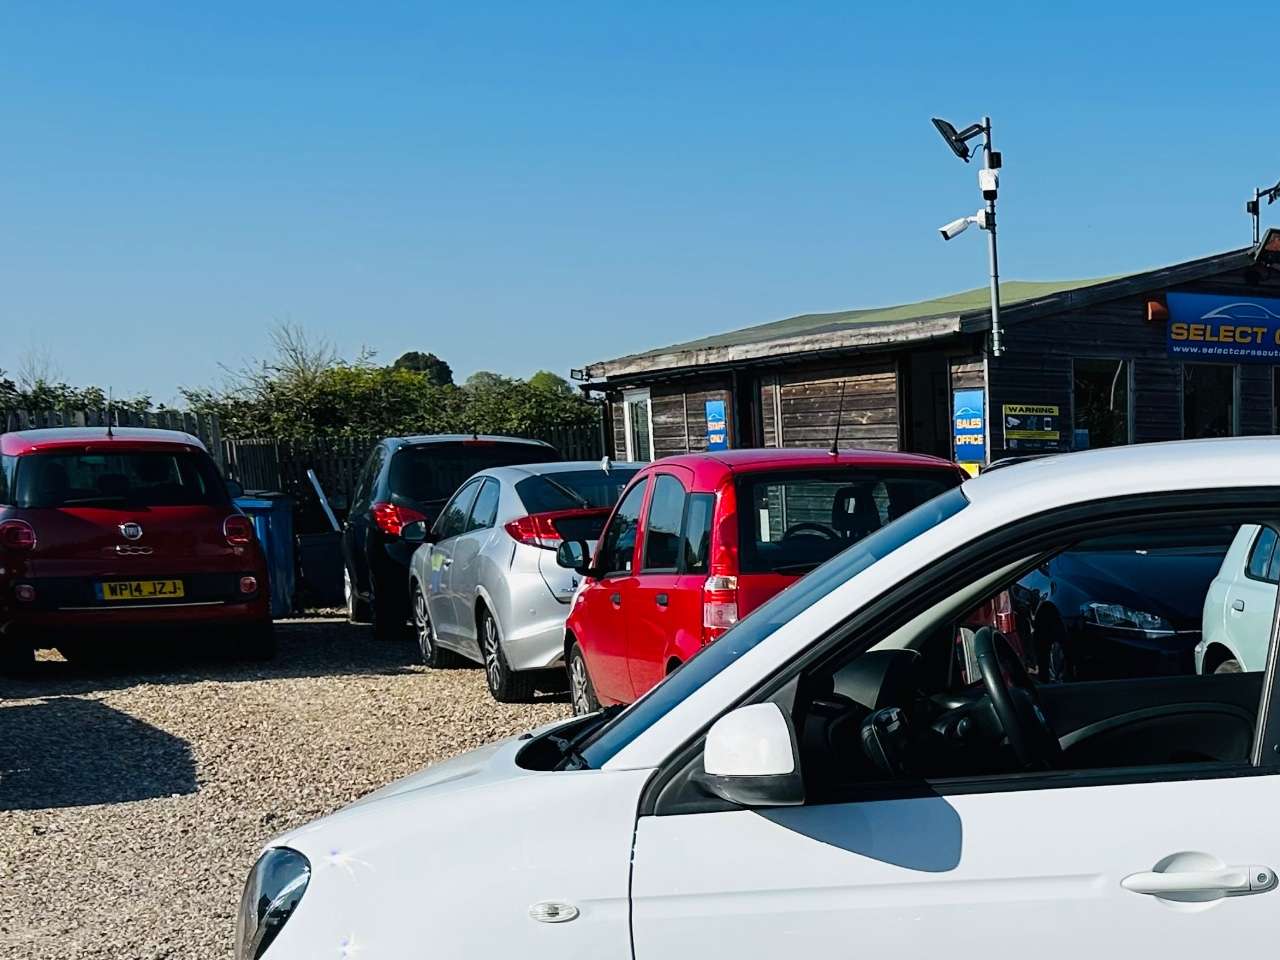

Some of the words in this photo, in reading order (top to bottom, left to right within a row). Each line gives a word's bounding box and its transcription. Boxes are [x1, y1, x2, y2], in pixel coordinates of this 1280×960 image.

[1171, 322, 1268, 344] SELECT
[1008, 406, 1055, 414] WARNING
[956, 418, 982, 429] SALES
[956, 435, 984, 445] OFFICE
[108, 583, 143, 597] WP14
[148, 582, 178, 595] JZJ
